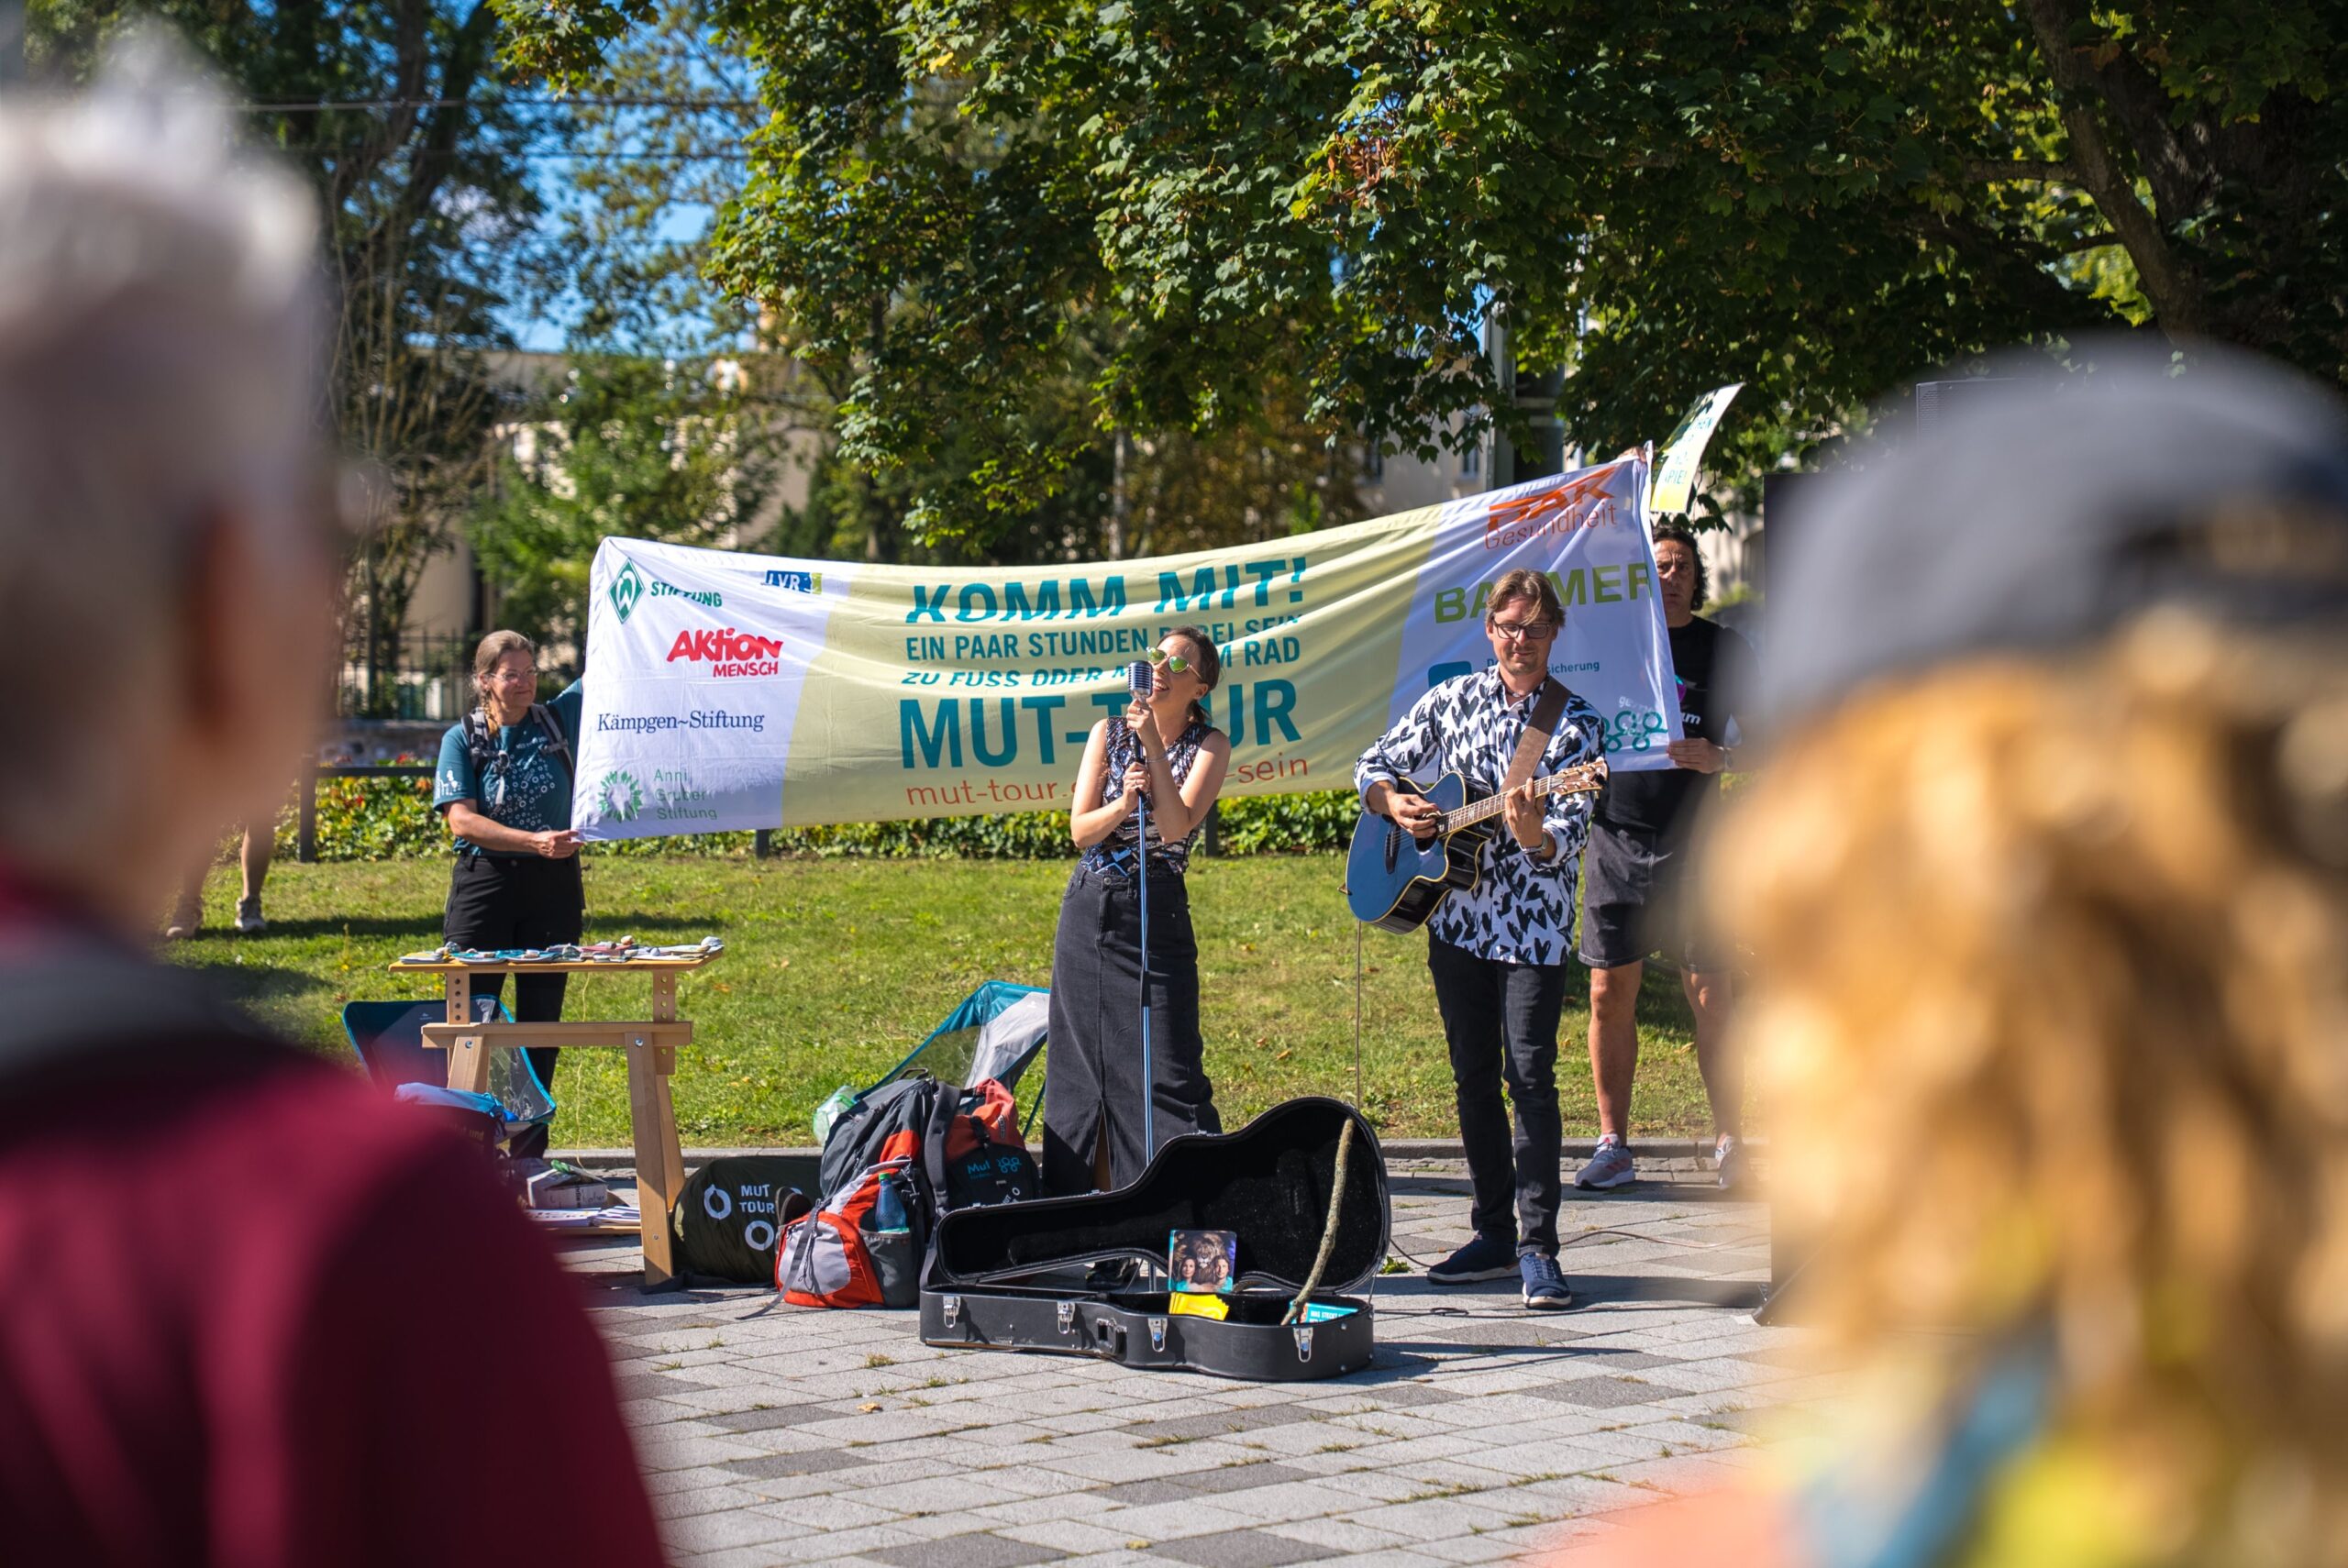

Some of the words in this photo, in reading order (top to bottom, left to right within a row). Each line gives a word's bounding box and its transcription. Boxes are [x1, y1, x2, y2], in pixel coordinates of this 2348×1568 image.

[905, 575, 1127, 624] KOMM
[1154, 557, 1307, 613] MIT!
[1434, 562, 1652, 624] BAMER
[906, 636, 945, 660] EIN
[955, 634, 1019, 659] PAAR
[1028, 627, 1147, 657] STUNDEN
[1245, 636, 1301, 667] RAD
[713, 661, 779, 678] MENSCH
[901, 672, 941, 685] ZU
[948, 668, 1022, 687] FUSS
[1031, 667, 1103, 686] ODER
[653, 768, 688, 782] Anni
[654, 787, 706, 803] Gruber
[657, 806, 717, 820] Stiftung
[741, 1184, 770, 1198] MUT
[738, 1200, 776, 1214] TOUR
